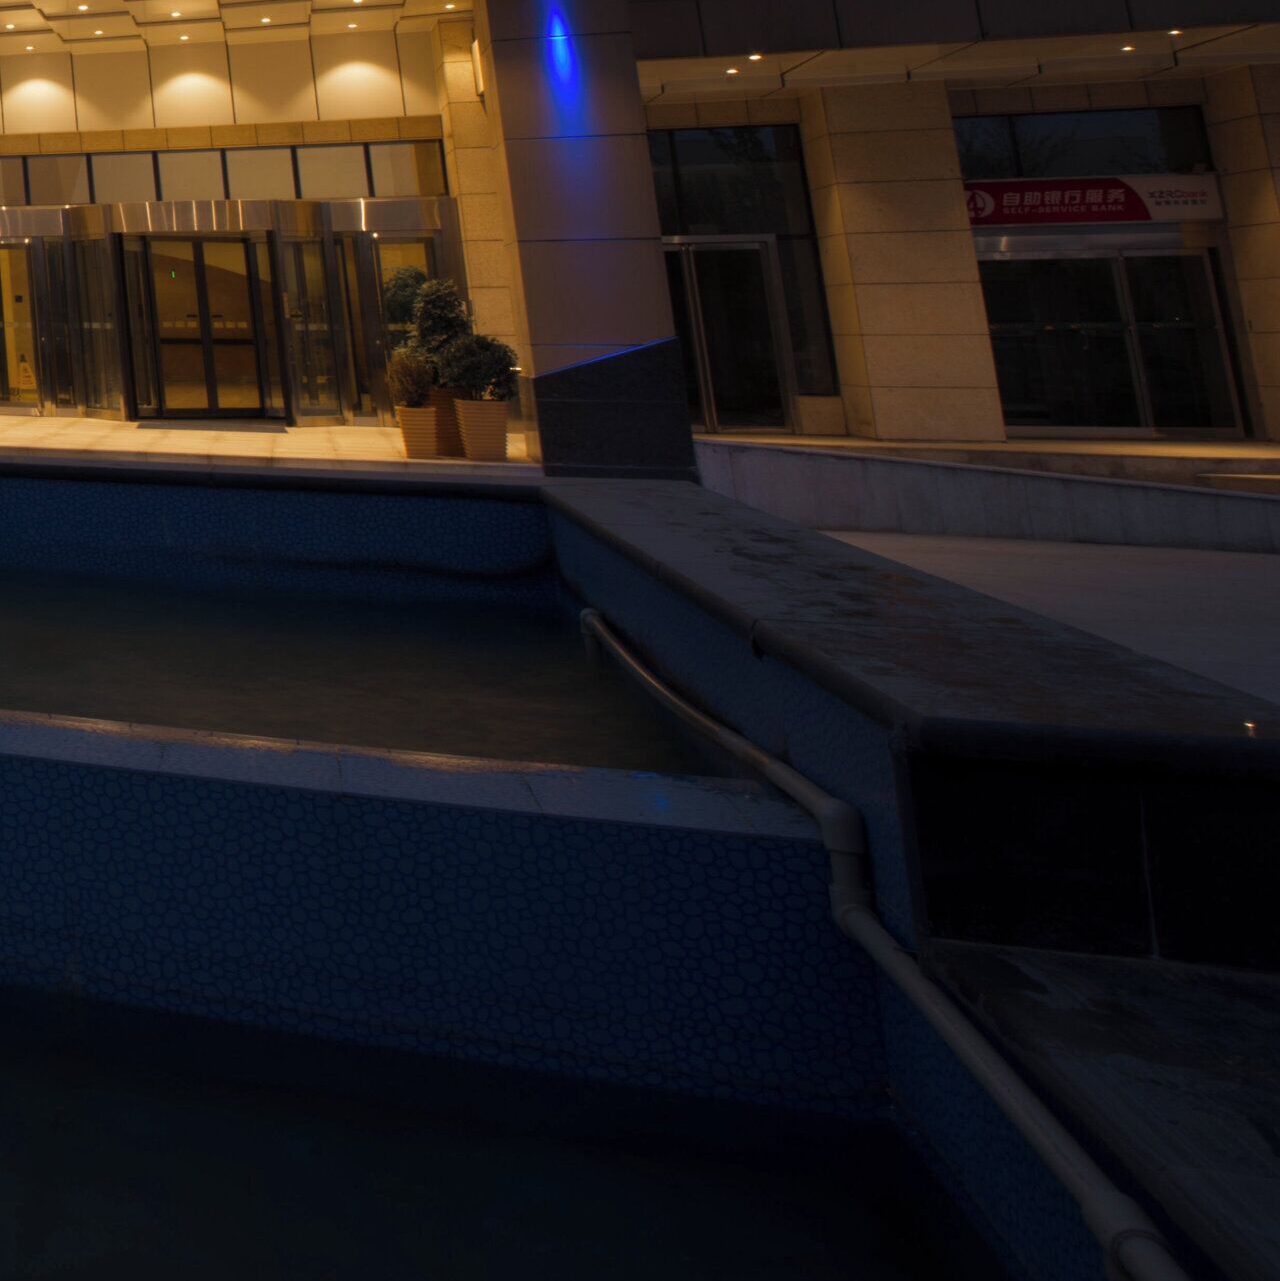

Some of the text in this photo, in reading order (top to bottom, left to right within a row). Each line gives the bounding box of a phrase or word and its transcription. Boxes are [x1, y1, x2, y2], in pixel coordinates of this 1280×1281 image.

[1002, 188, 1126, 207] 自助银行服务
[1002, 203, 1125, 214] SELF-SERVICE BANK
